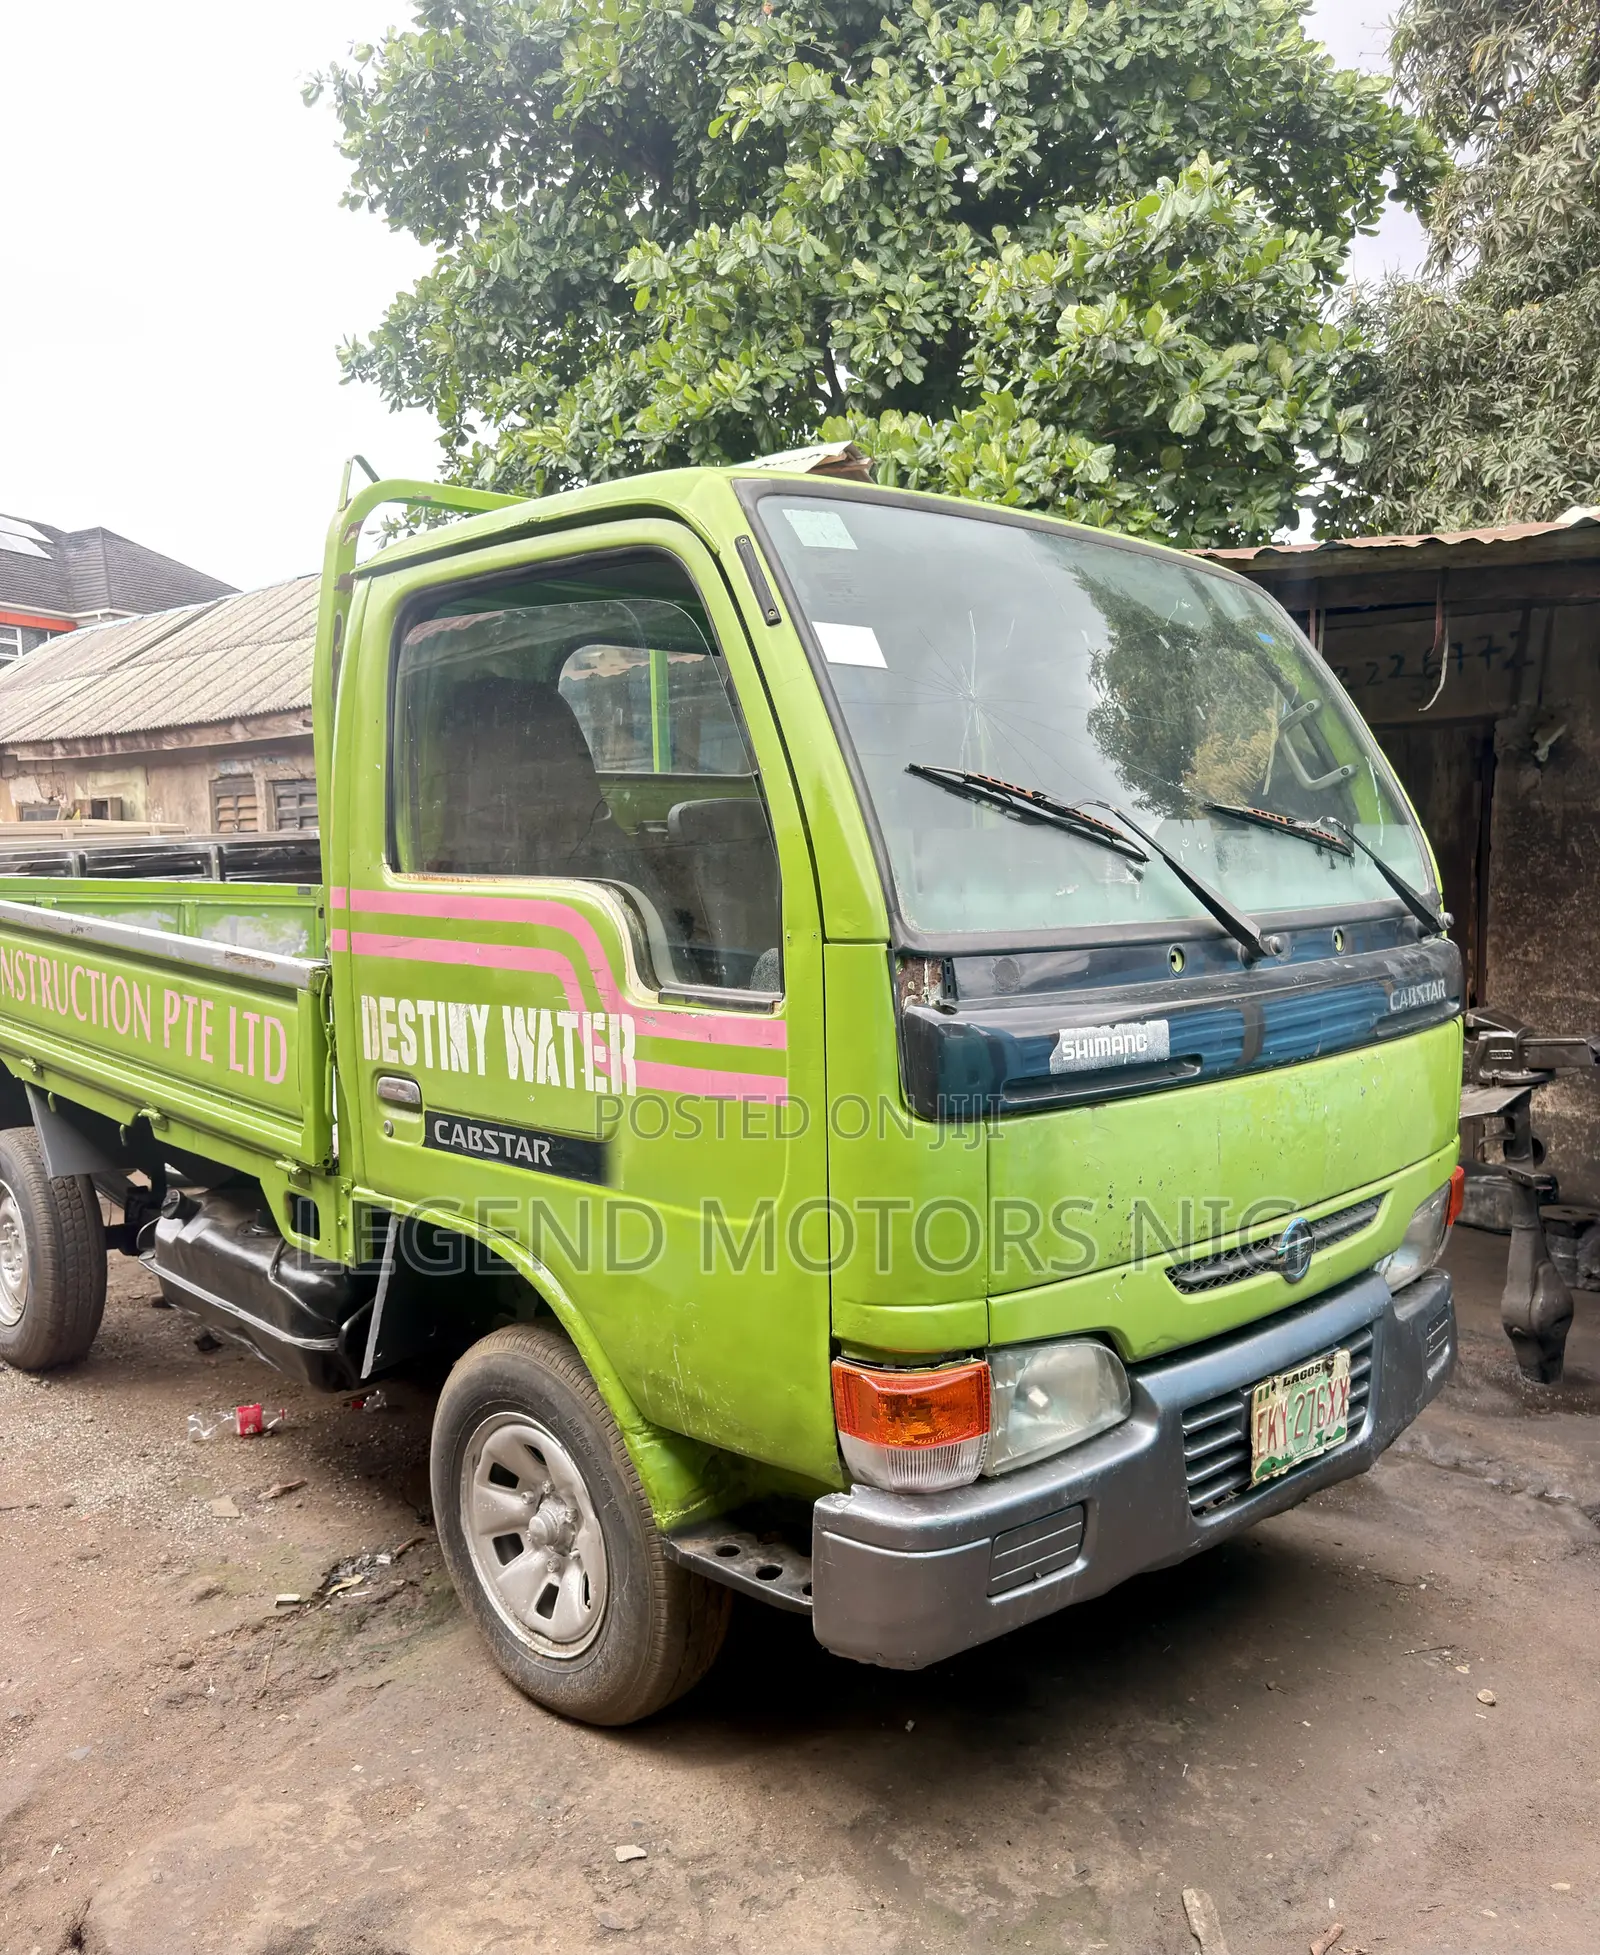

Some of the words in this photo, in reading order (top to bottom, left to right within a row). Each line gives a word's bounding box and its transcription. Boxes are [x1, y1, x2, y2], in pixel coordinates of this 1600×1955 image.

[1389, 979, 1447, 1011] CABSTAR
[163, 988, 214, 1064] PTE
[229, 1005, 287, 1085] LTD
[361, 995, 490, 1076] DESTINY
[502, 1005, 637, 1096] WATER
[434, 1120, 552, 1167] CABSTAR
[1282, 1363, 1322, 1387] LAGOS
